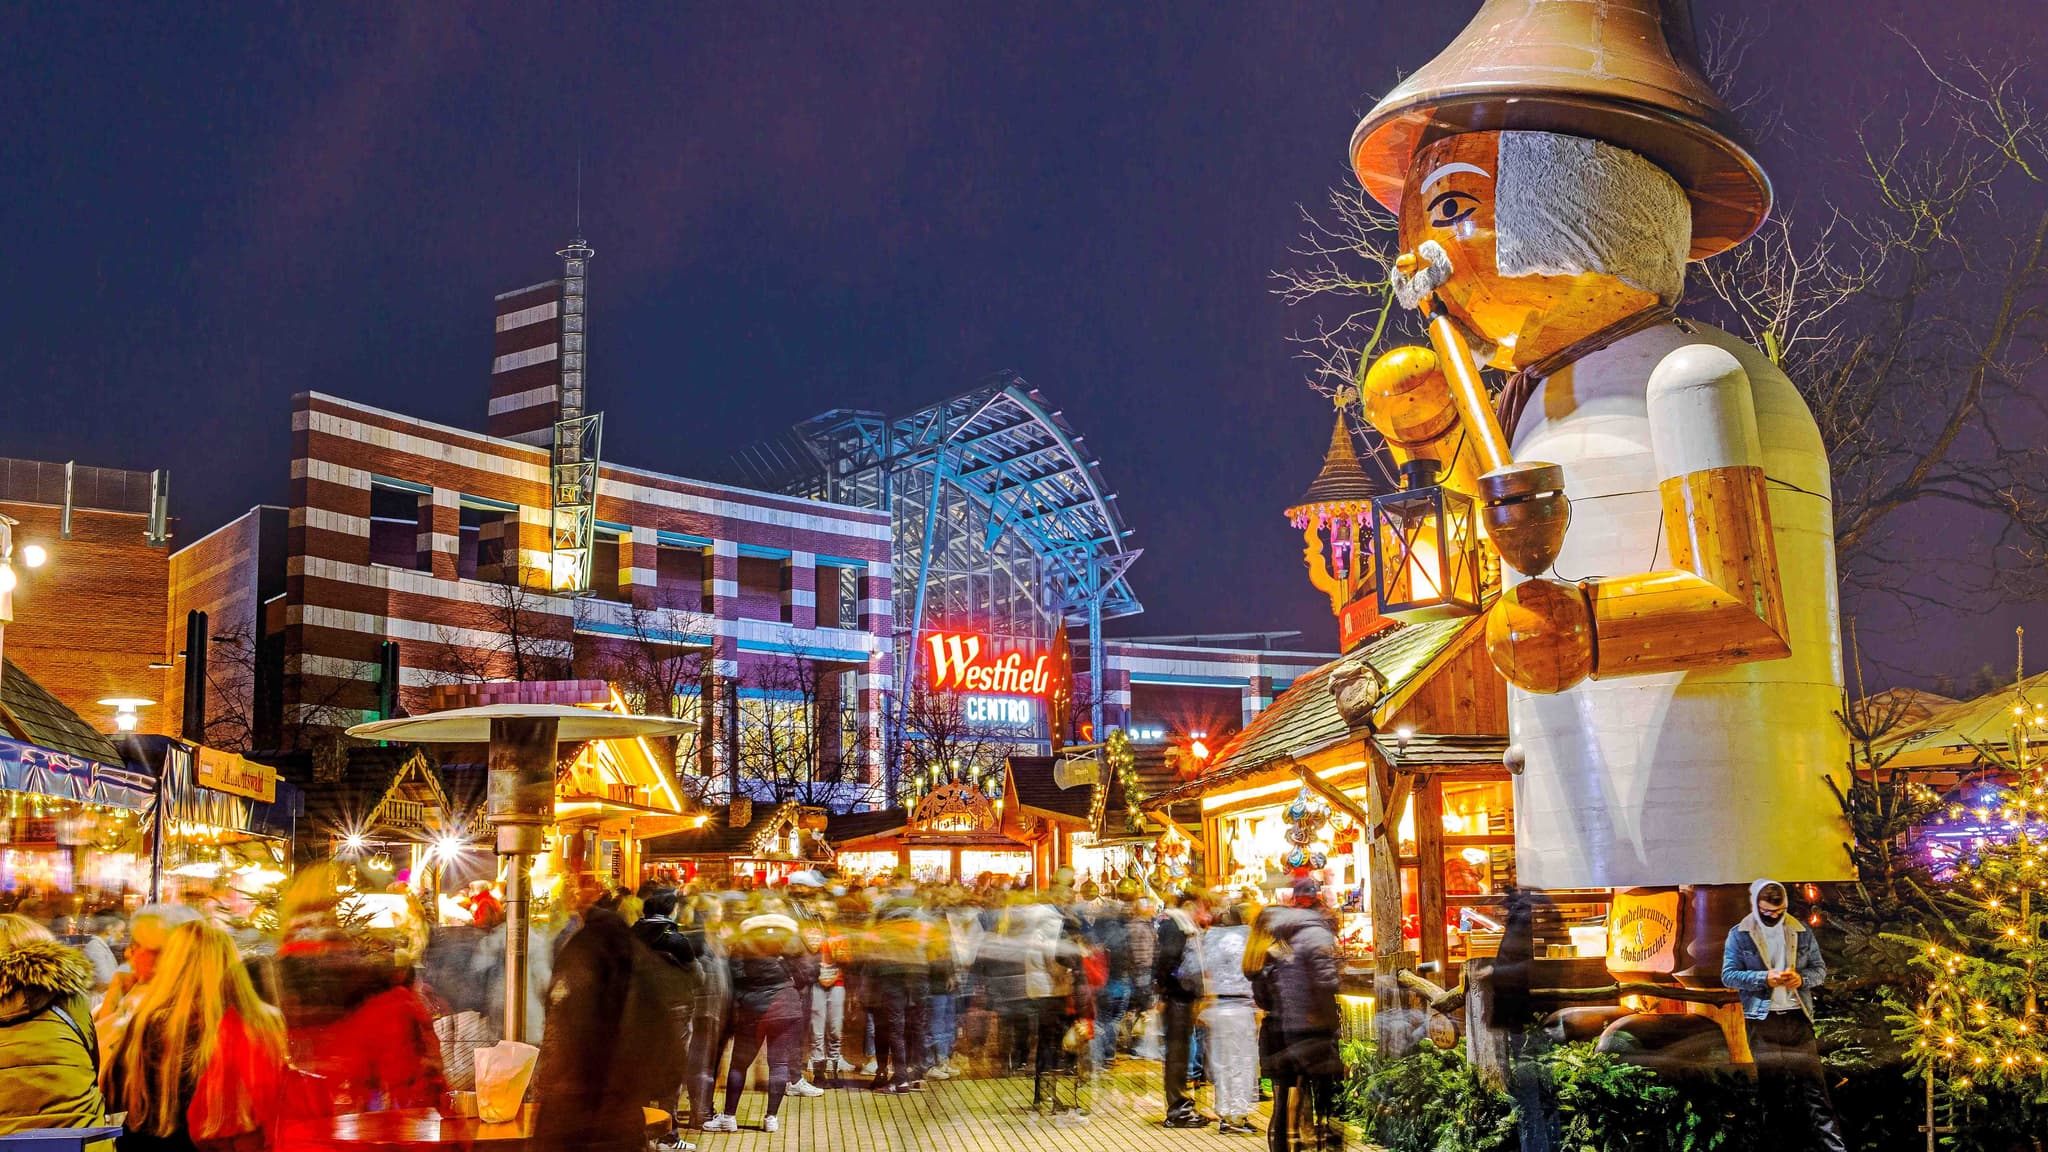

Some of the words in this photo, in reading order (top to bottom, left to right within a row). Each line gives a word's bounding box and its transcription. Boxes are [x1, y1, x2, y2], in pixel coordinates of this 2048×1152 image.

[967, 697, 1030, 723] CENTRO
[1634, 920, 1645, 945] &
[1614, 933, 1668, 963] chokofrüchte
